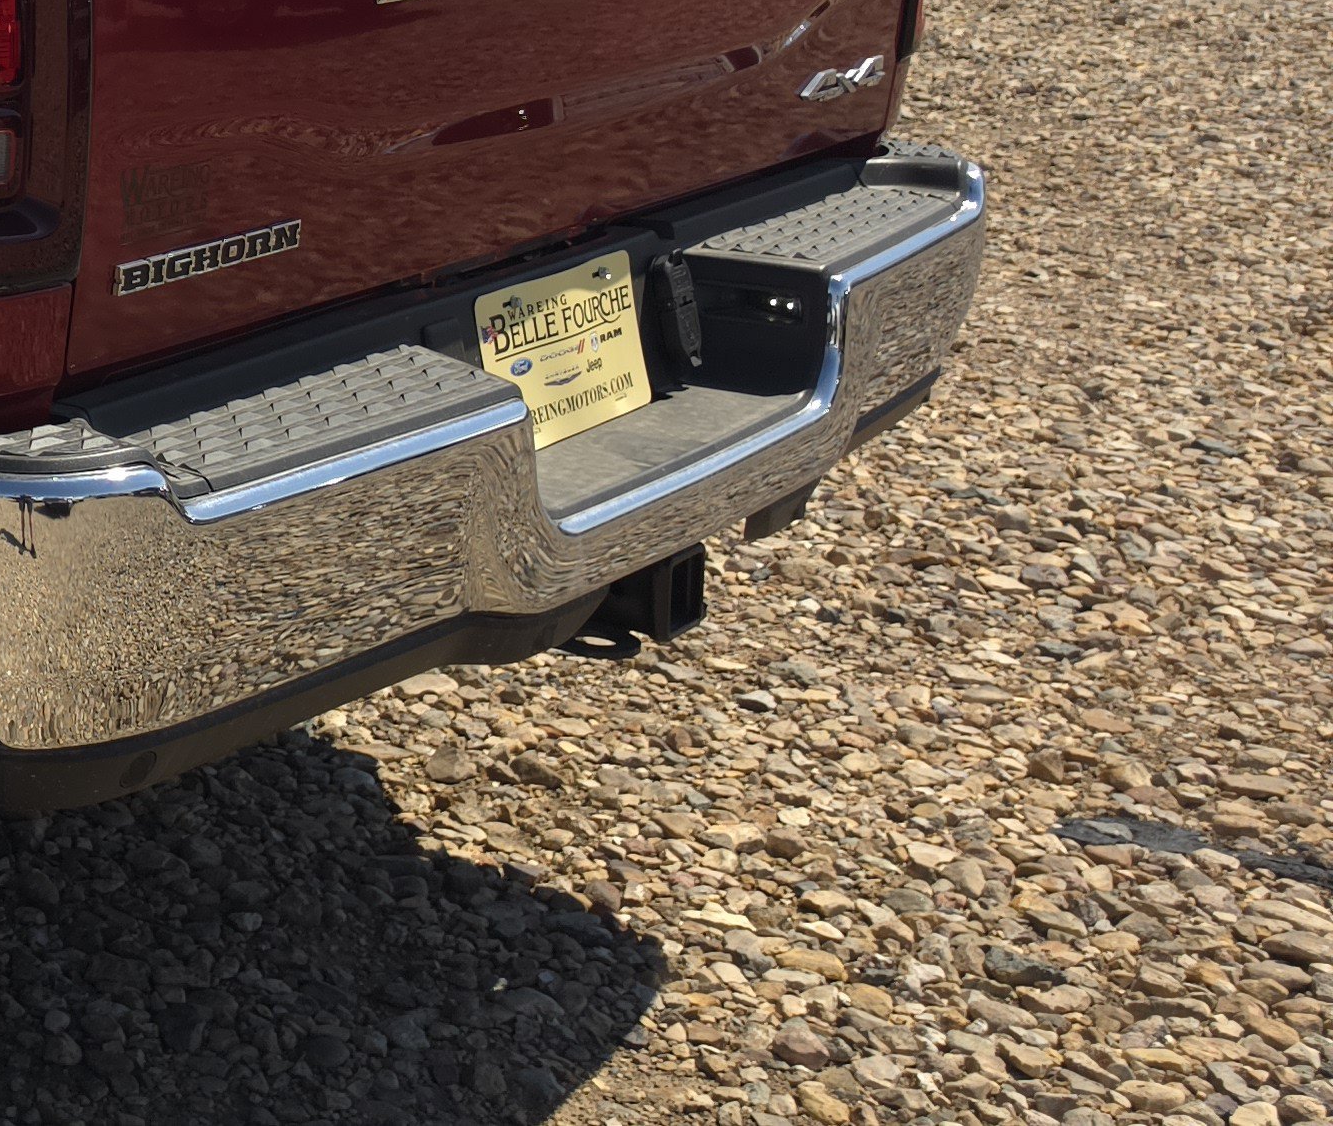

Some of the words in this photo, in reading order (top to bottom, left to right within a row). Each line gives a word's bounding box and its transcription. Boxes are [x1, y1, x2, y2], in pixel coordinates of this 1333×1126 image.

[115, 219, 301, 296] BIGHORN
[489, 313, 559, 355] BELLE
[562, 285, 632, 338] FOURCHE
[507, 294, 568, 320] WAREING
[599, 327, 623, 344] RAM
[586, 357, 603, 373] Jeep
[530, 372, 634, 426] REINGMOTORS.COM
